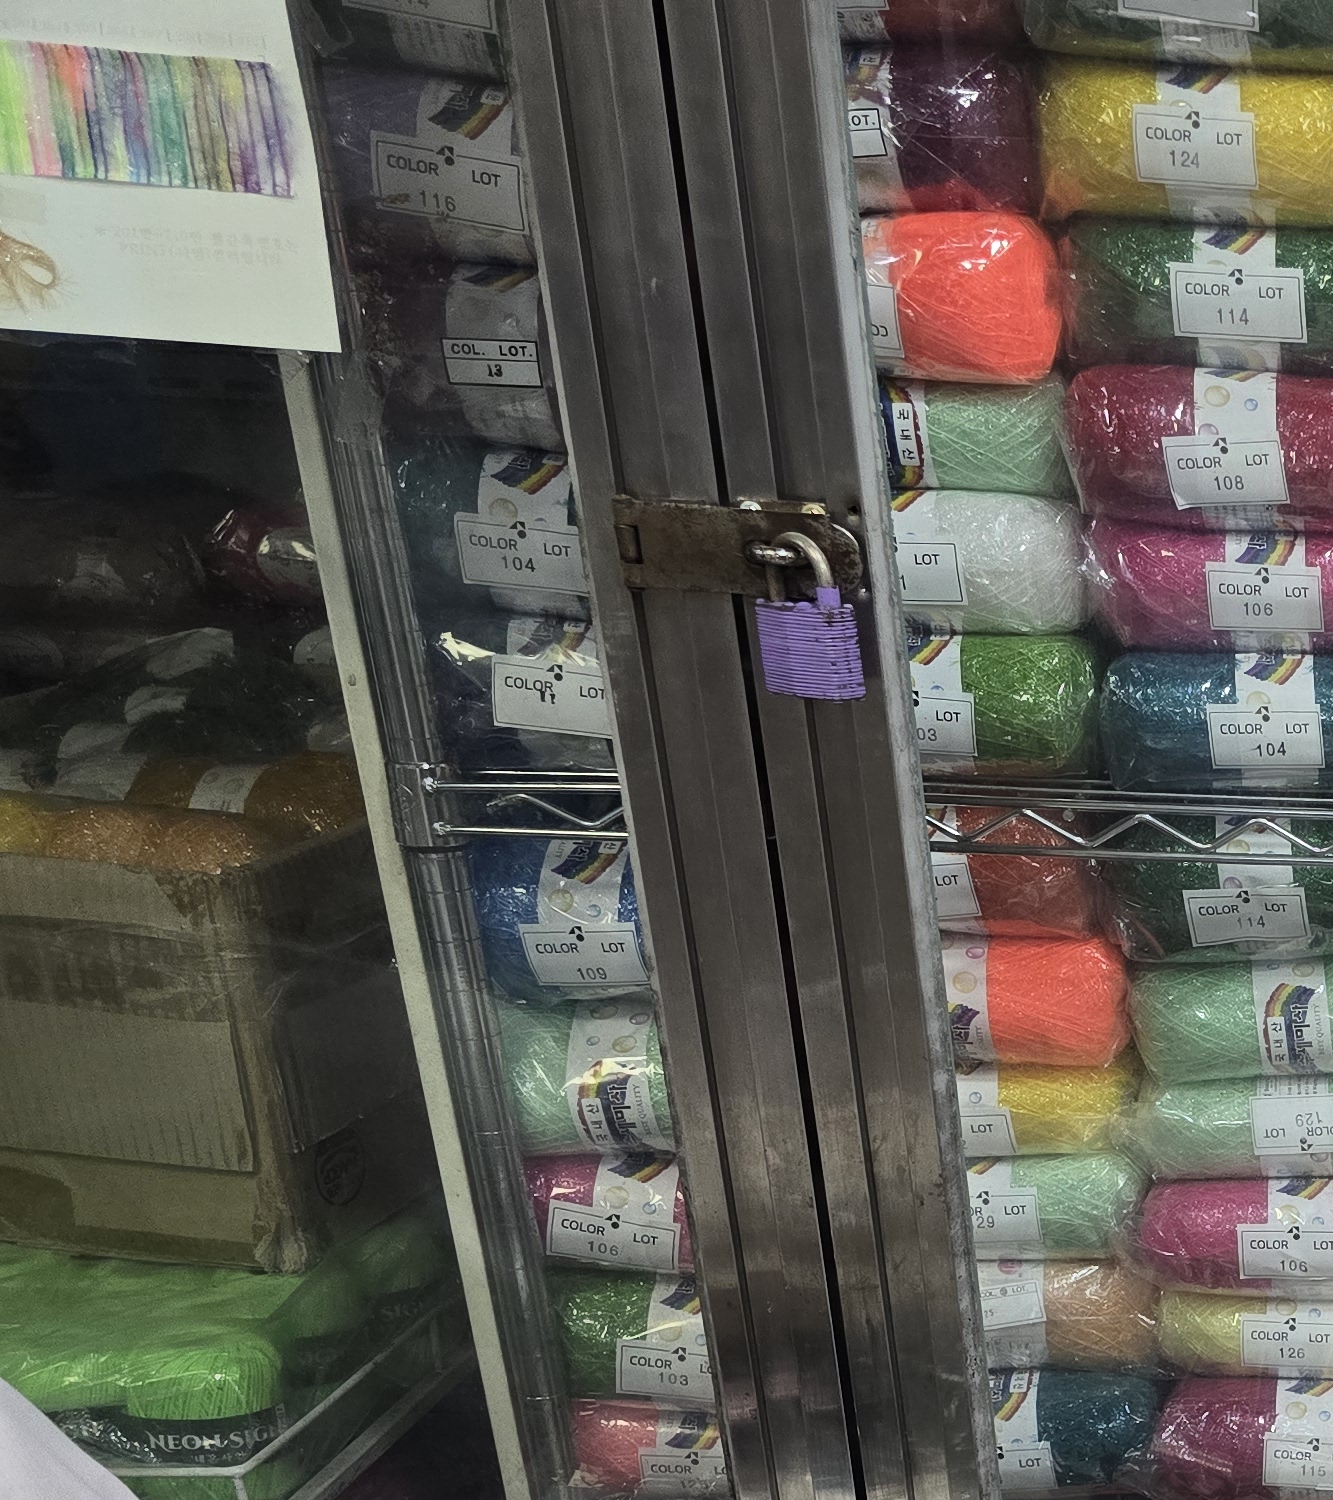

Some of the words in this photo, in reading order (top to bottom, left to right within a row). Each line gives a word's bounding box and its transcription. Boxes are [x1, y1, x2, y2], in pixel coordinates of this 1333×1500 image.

[1146, 127, 1191, 142] COLOR
[1217, 132, 1242, 146] LOT
[1170, 150, 1199, 168] 124
[386, 154, 439, 176] COLOR
[472, 170, 501, 187] LOT
[416, 187, 456, 212] 116
[896, 408, 915, 461] 국내산
[1177, 457, 1222, 470] COLOR
[1245, 454, 1269, 466] LOT
[1214, 475, 1244, 490] 108
[469, 534, 518, 551] COLOR
[544, 543, 571, 559] LOT
[502, 556, 536, 572] 104
[1198, 905, 1240, 916] COLOR
[1264, 903, 1287, 912] LOT
[1237, 916, 1265, 928] 114
[535, 943, 579, 954] COLOR
[601, 942, 625, 953] LOT
[577, 967, 607, 980] 109
[1250, 1240, 1288, 1249] COLOR
[1280, 1260, 1308, 1273] 106
[630, 1356, 672, 1370] COLOR
[659, 1372, 688, 1388] 103
[148, 1431, 228, 1452] NEON
